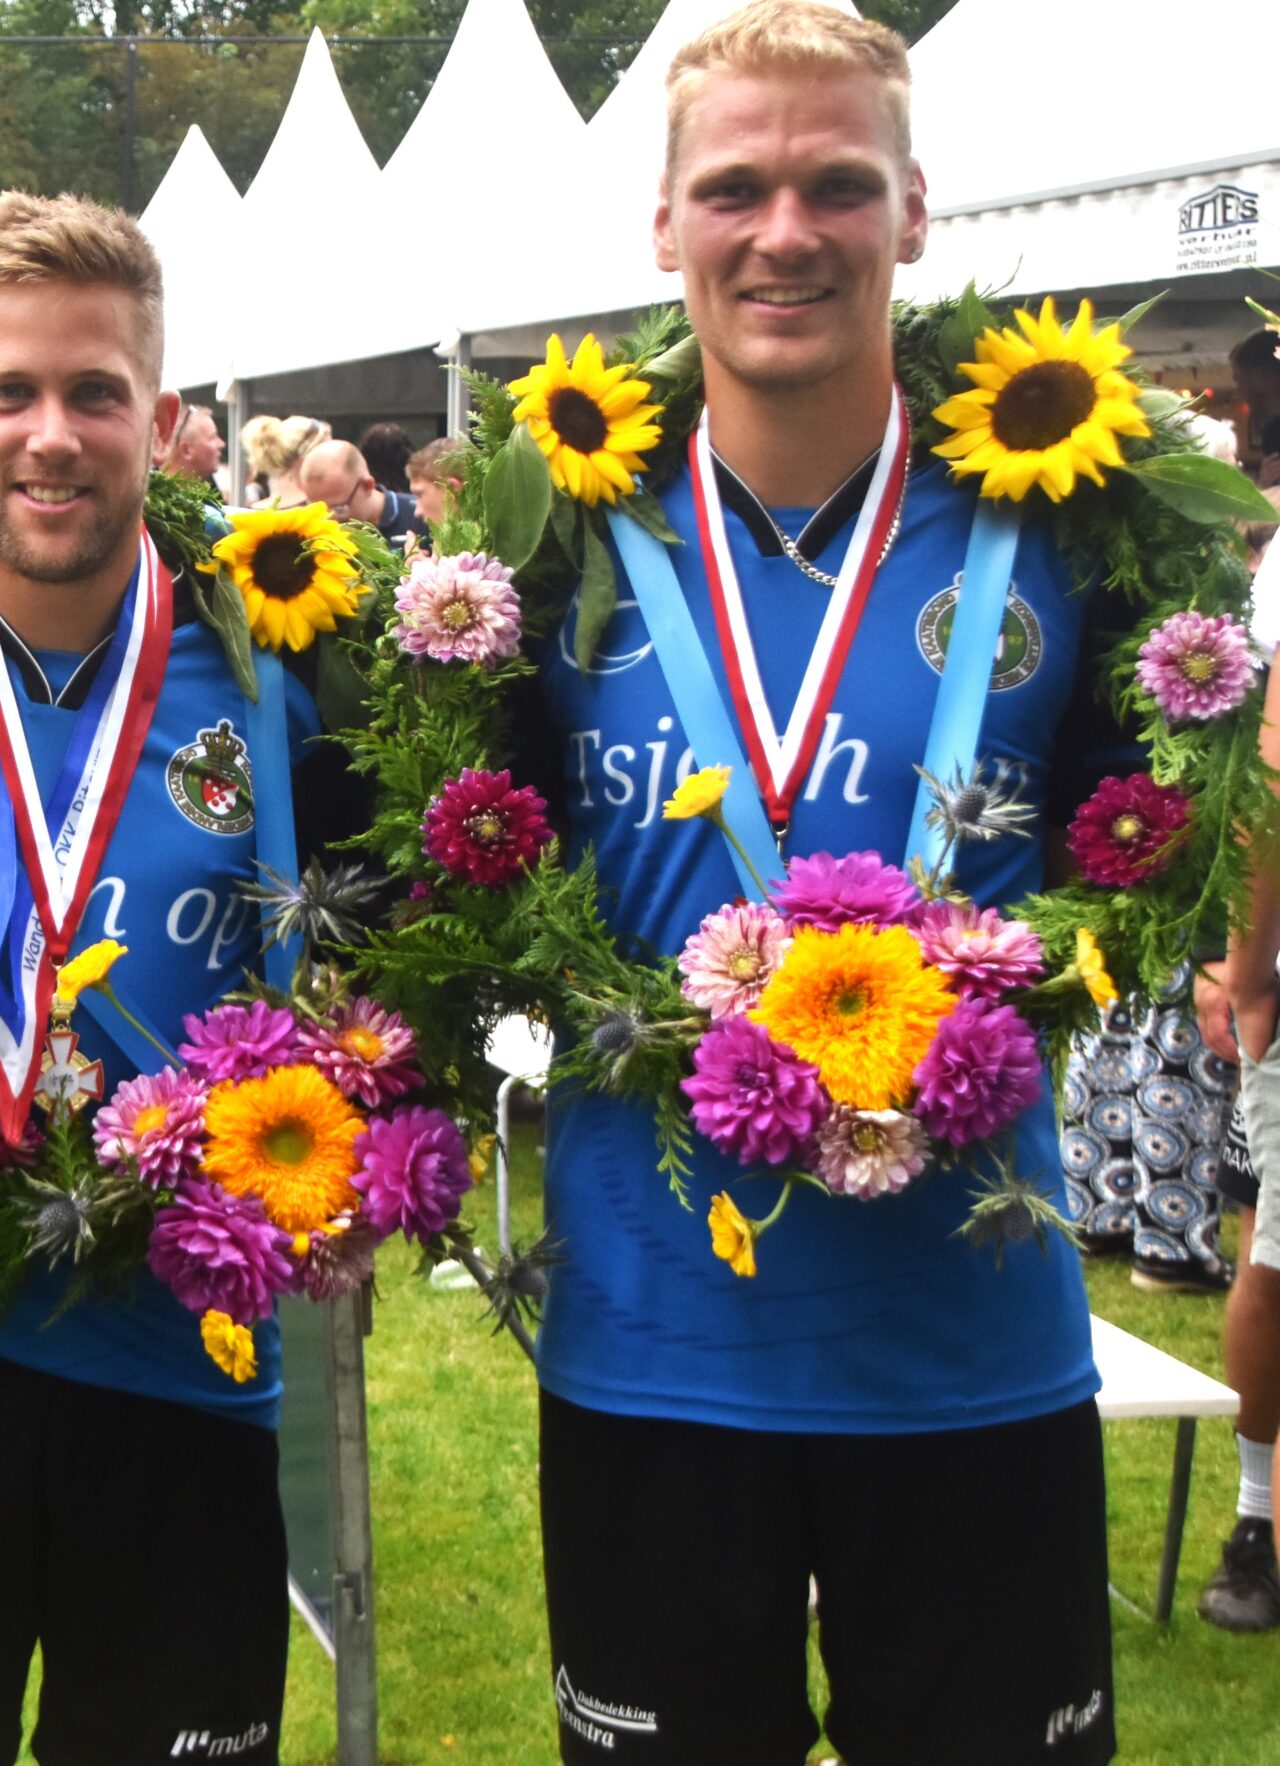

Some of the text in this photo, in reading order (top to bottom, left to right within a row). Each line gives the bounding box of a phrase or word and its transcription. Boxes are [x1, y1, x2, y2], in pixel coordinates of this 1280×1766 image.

[166, 887, 251, 970] op
[577, 1690, 656, 1723] Dakbedekking
[207, 1721, 268, 1757] muta
